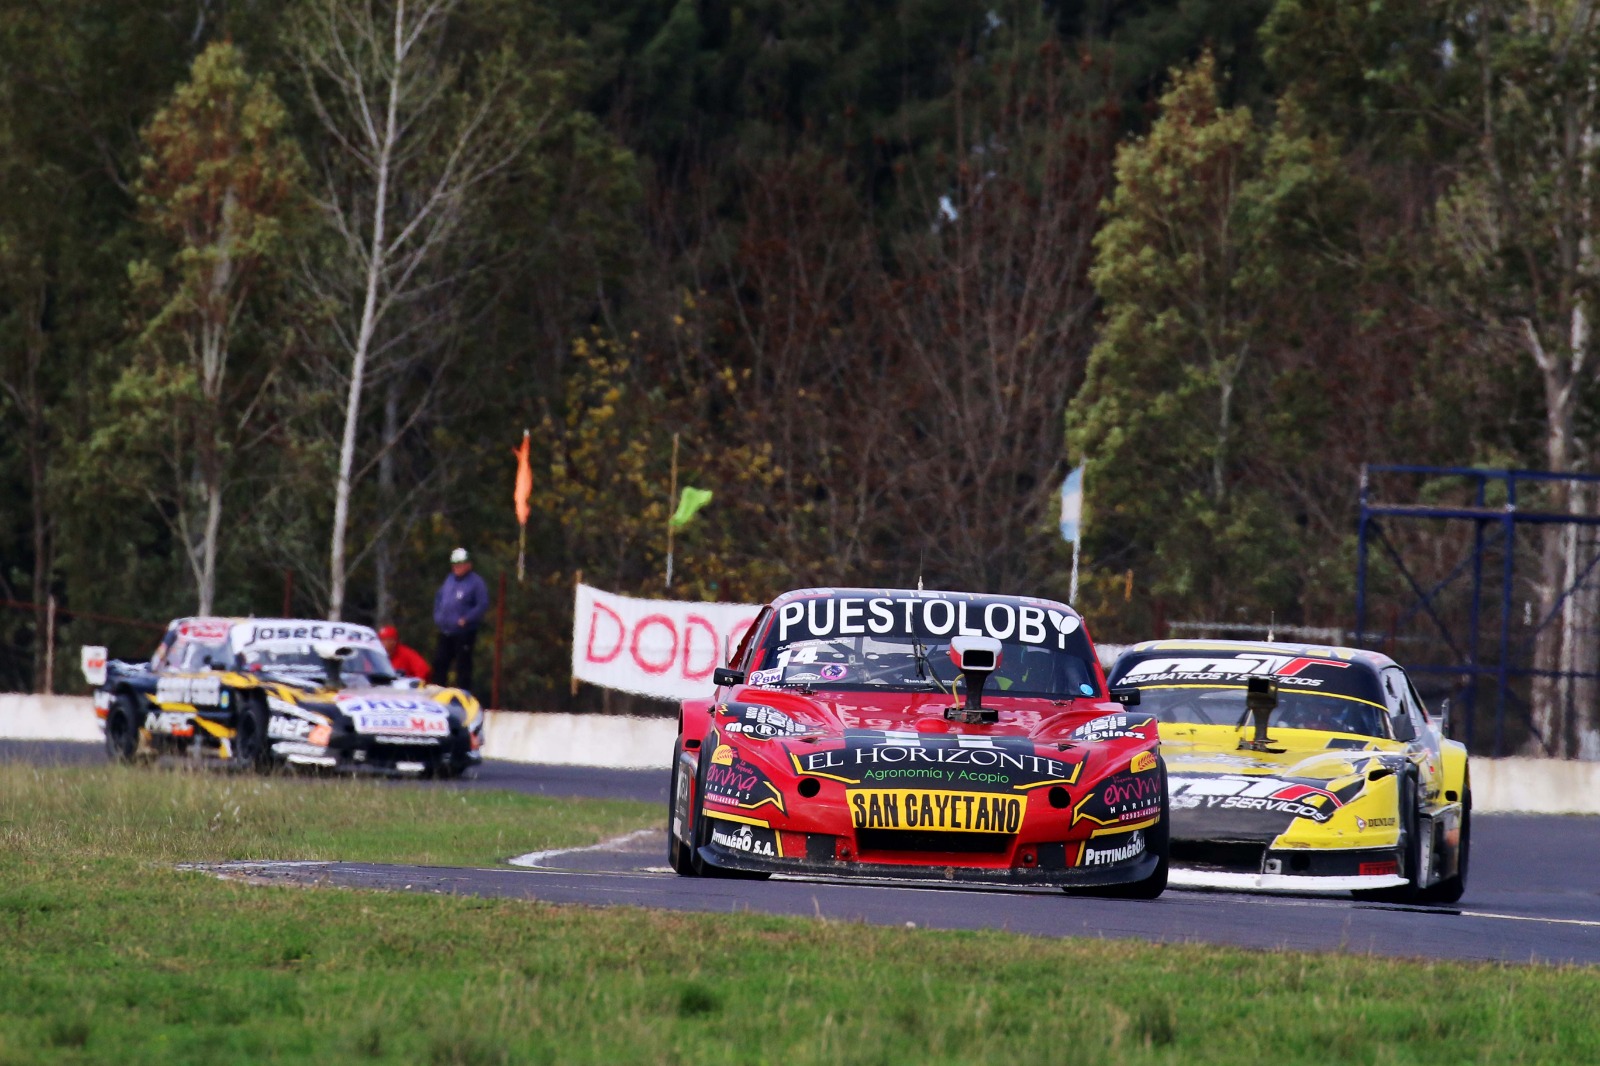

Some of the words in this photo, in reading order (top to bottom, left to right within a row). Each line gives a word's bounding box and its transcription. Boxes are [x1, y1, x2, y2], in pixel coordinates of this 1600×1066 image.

[776, 647, 819, 669] 14
[1224, 673, 1238, 681] Y
[808, 752, 844, 770] EL
[855, 746, 1066, 778] HORIZONTE
[864, 766, 943, 781] Agronomía
[946, 769, 954, 781] y
[958, 769, 1009, 784] Acopio
[853, 793, 899, 829] SAN
[905, 794, 1021, 833] CAYETANO
[1220, 796, 1328, 821] SERVICIOS
[752, 840, 775, 856] S.A.
[1085, 838, 1142, 866] PETTINAGRO
